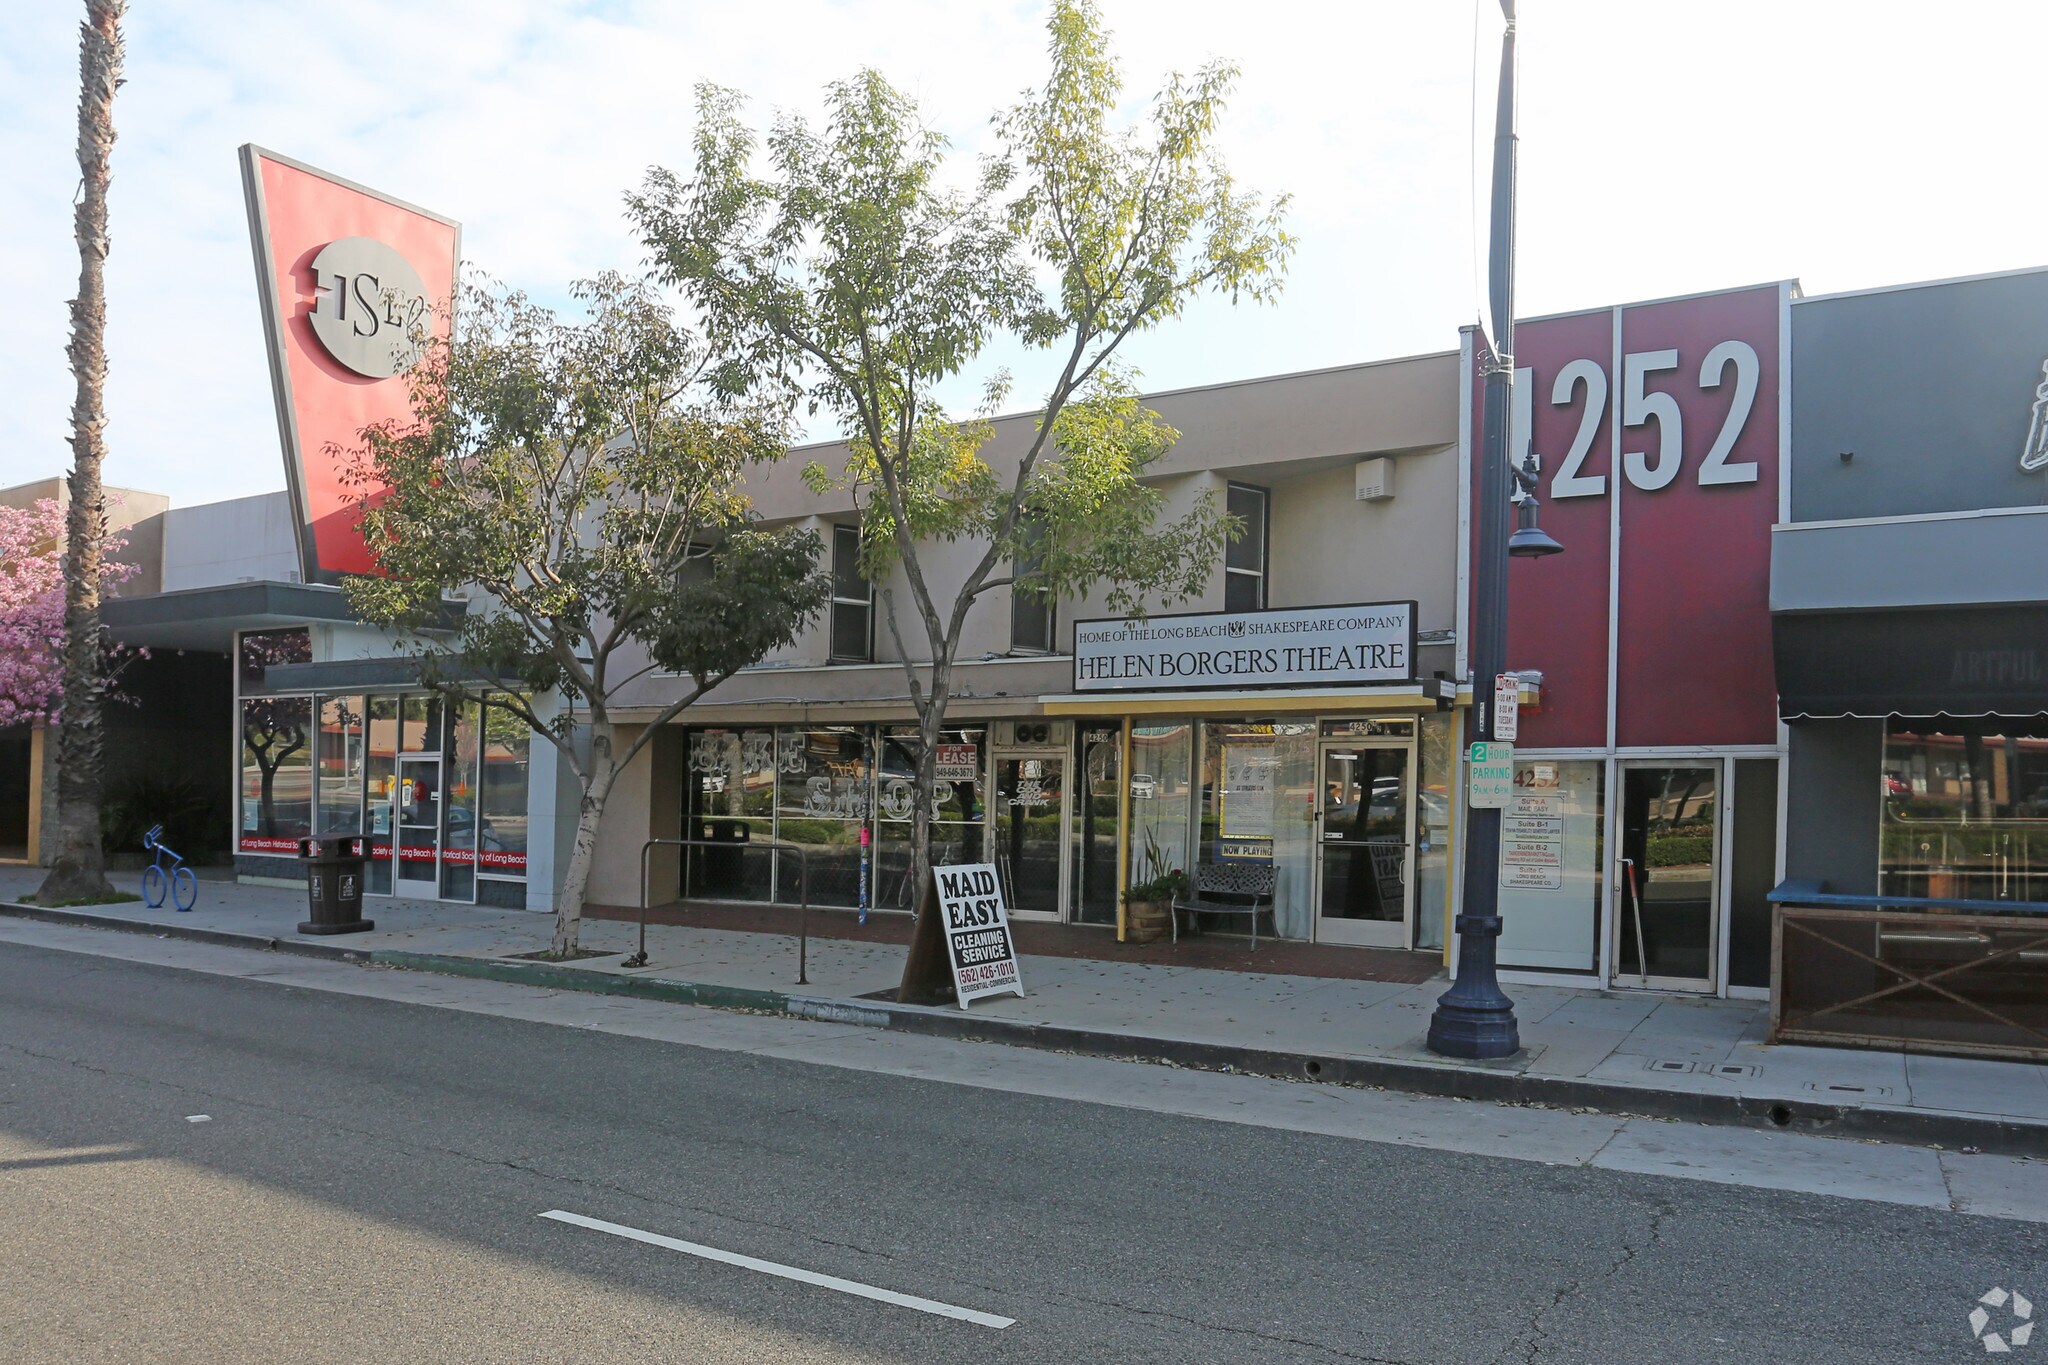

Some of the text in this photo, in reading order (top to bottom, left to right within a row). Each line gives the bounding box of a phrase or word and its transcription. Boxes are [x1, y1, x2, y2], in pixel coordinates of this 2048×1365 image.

[1079, 615, 1406, 644] HOME OF THE LONG BEACH SHAKESPEARE COMPANY
[1078, 643, 1406, 680] HELEN BORGERS THEATRE
[1350, 723, 1372, 731] 4250
[936, 752, 975, 764] LEASE
[1475, 746, 1511, 760] 2 HOUR
[936, 767, 974, 778] 949-646-3679
[1472, 767, 1511, 780] PARKING
[1517, 820, 1535, 828] Suite
[372, 846, 388, 857] ociety
[400, 847, 412, 858] Long
[413, 848, 431, 857] Beach
[431, 849, 461, 859] Hstorical
[485, 854, 491, 862] of
[492, 854, 507, 865] Long
[507, 855, 528, 865] Beach
[1223, 845, 1273, 856] NOW PLAYING
[940, 870, 995, 899] MAID
[946, 898, 1000, 929] EASY
[954, 930, 1005, 950] CLEANING
[961, 944, 1006, 963] SERVICE
[959, 961, 1015, 985] (562) 426-1010
